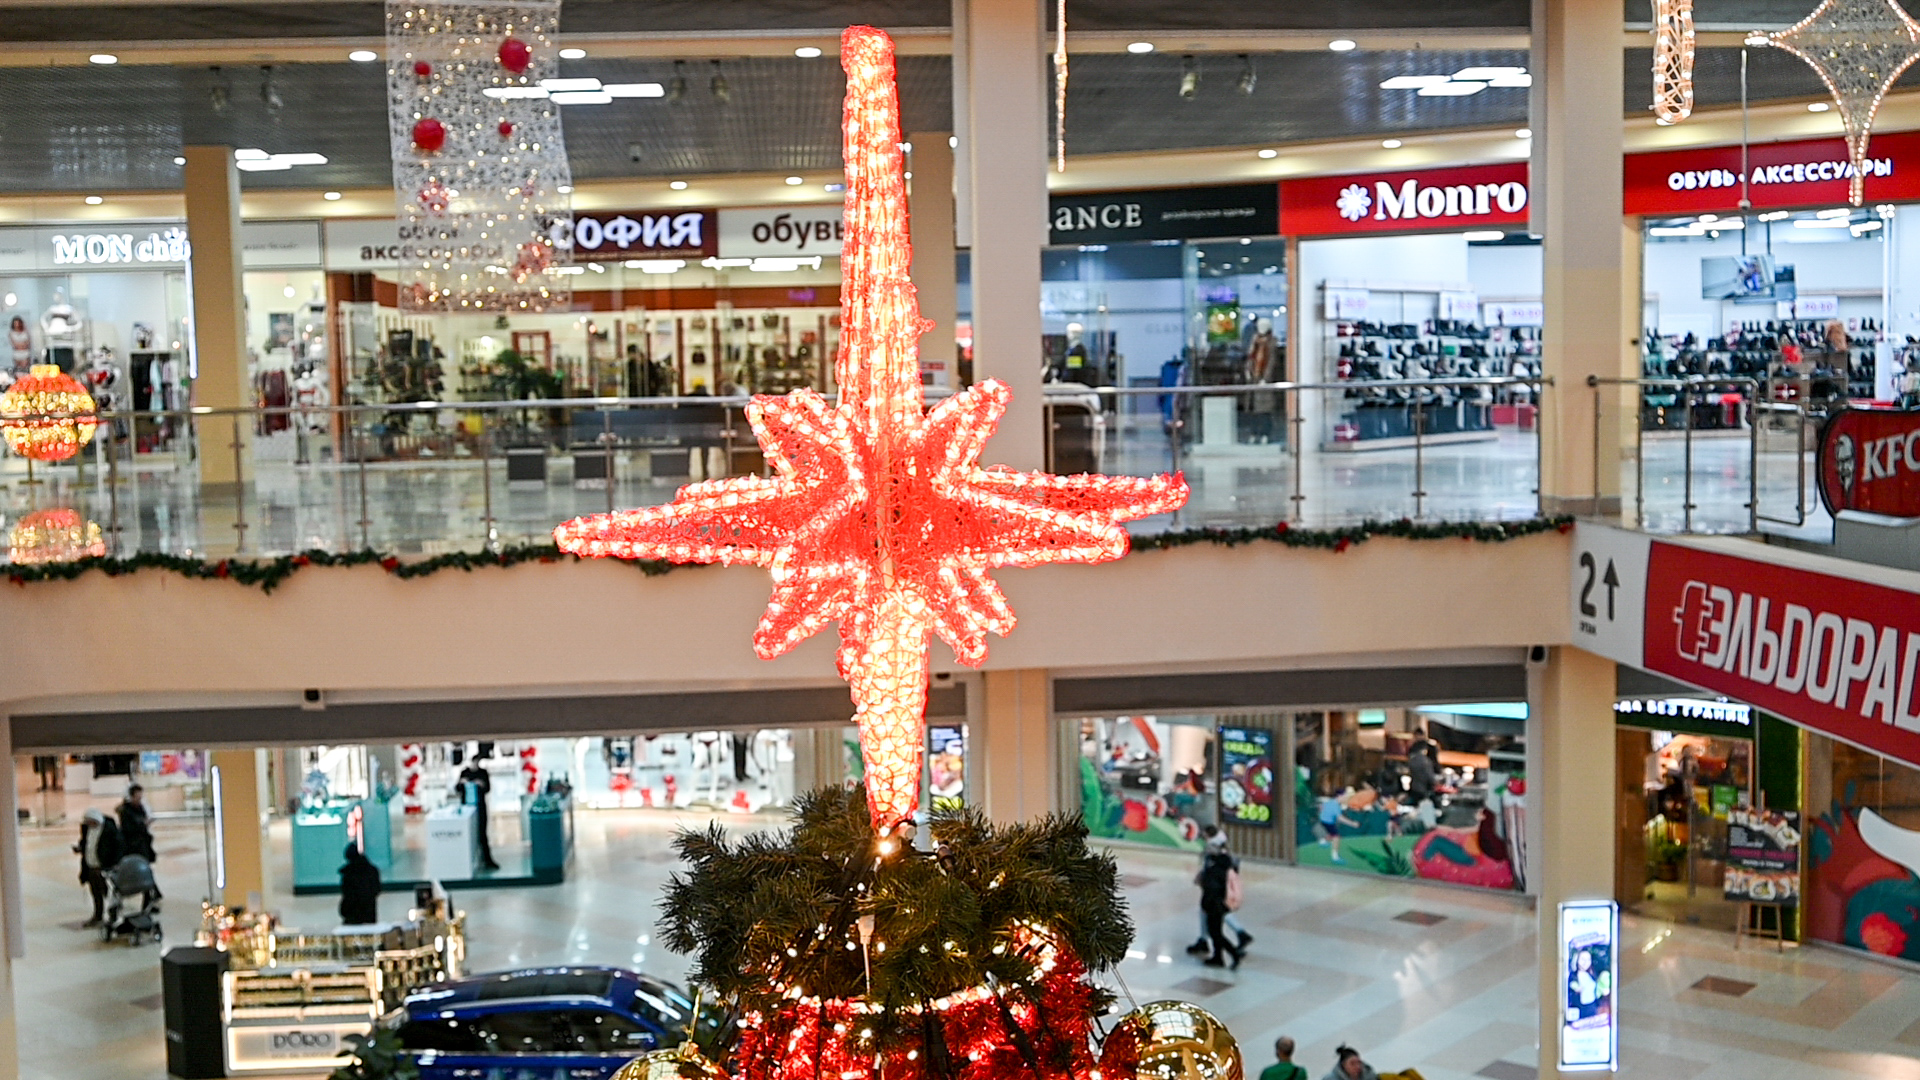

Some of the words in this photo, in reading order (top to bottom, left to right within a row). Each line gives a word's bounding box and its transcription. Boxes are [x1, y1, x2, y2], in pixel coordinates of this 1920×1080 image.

[1668, 169, 1736, 190] ОБУВЬ
[1374, 179, 1527, 221] Monro
[52, 234, 133, 264] MON
[551, 213, 704, 249] СОФИЯ
[1862, 429, 1920, 482] KFC
[1580, 550, 1597, 618] 2
